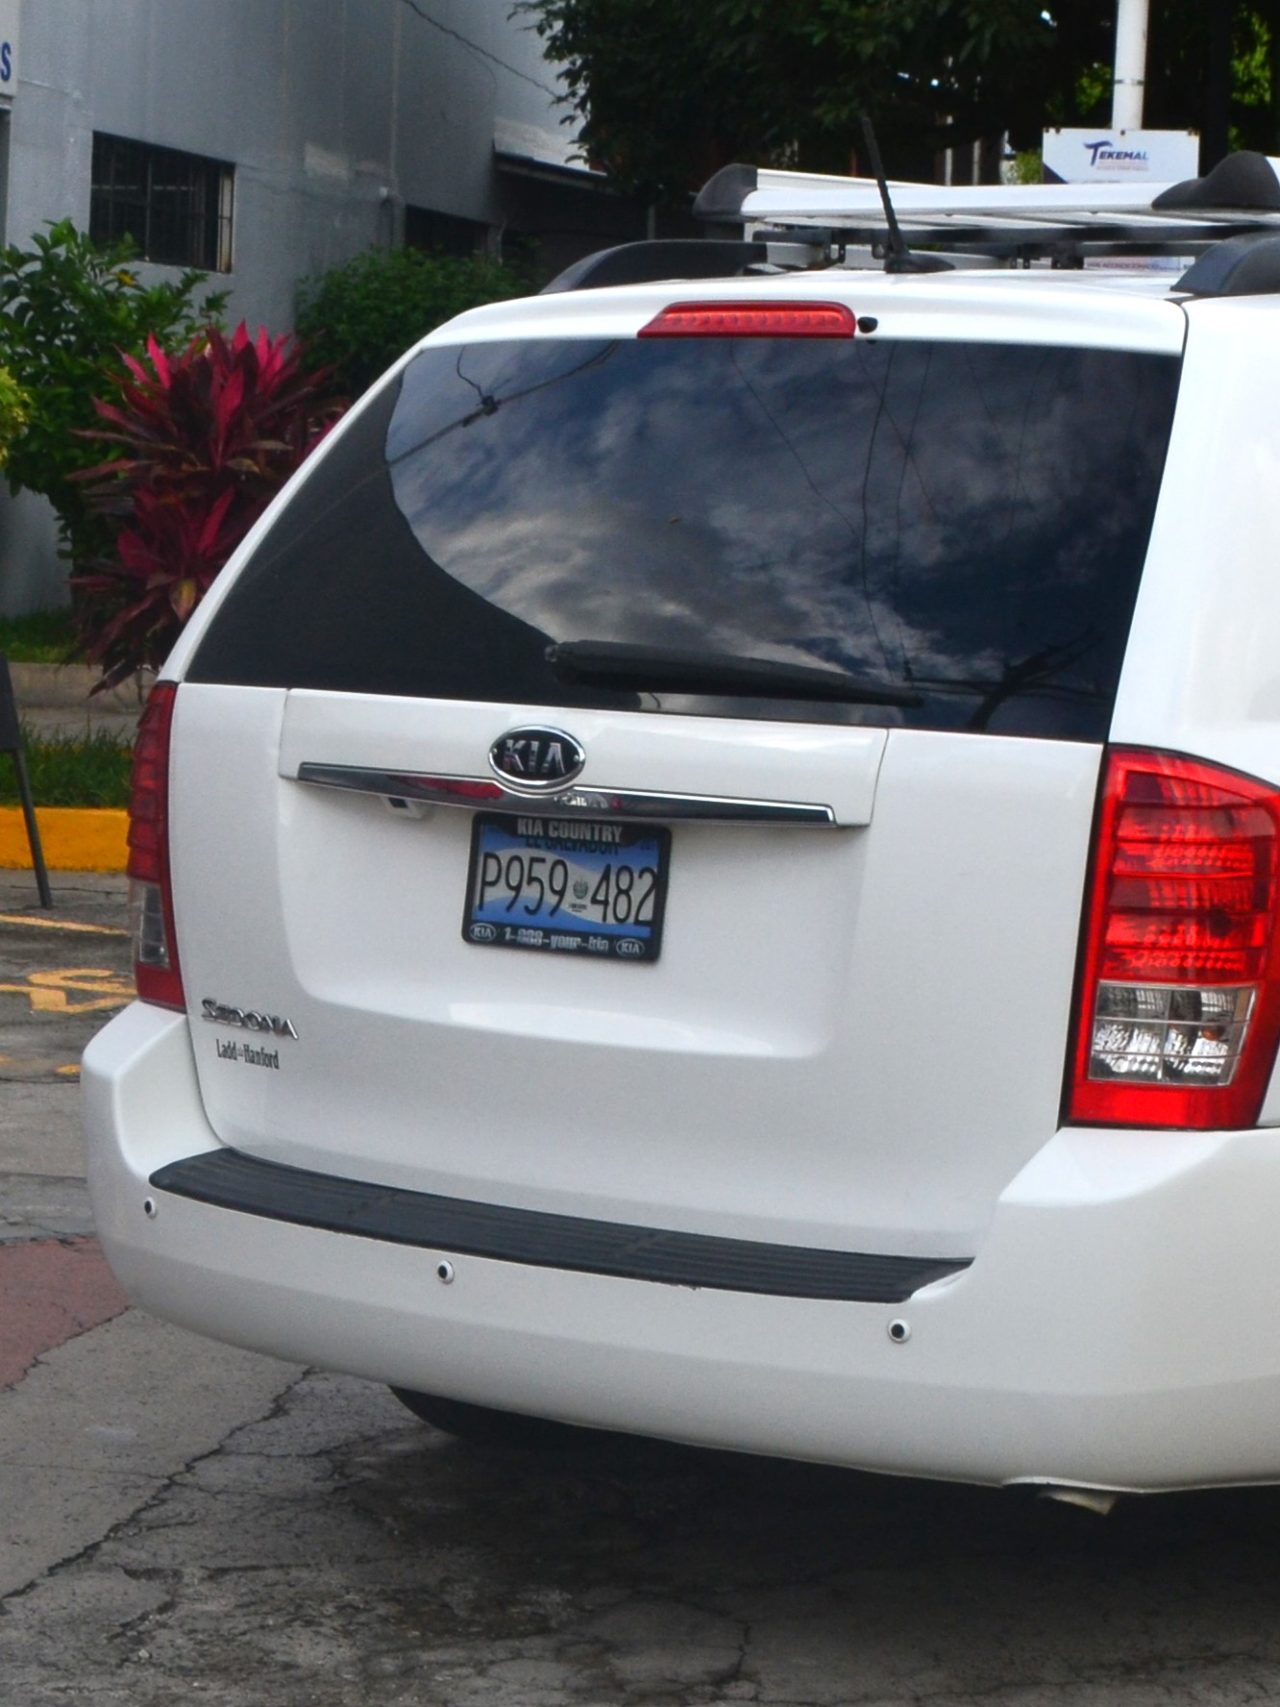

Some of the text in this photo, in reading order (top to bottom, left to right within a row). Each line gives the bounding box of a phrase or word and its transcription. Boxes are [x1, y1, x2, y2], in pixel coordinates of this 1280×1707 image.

[1083, 140, 1149, 166] TEKEMAL
[503, 739, 566, 774] KIA
[517, 818, 622, 842] KIA COUNTRY
[478, 852, 657, 926] P959 482
